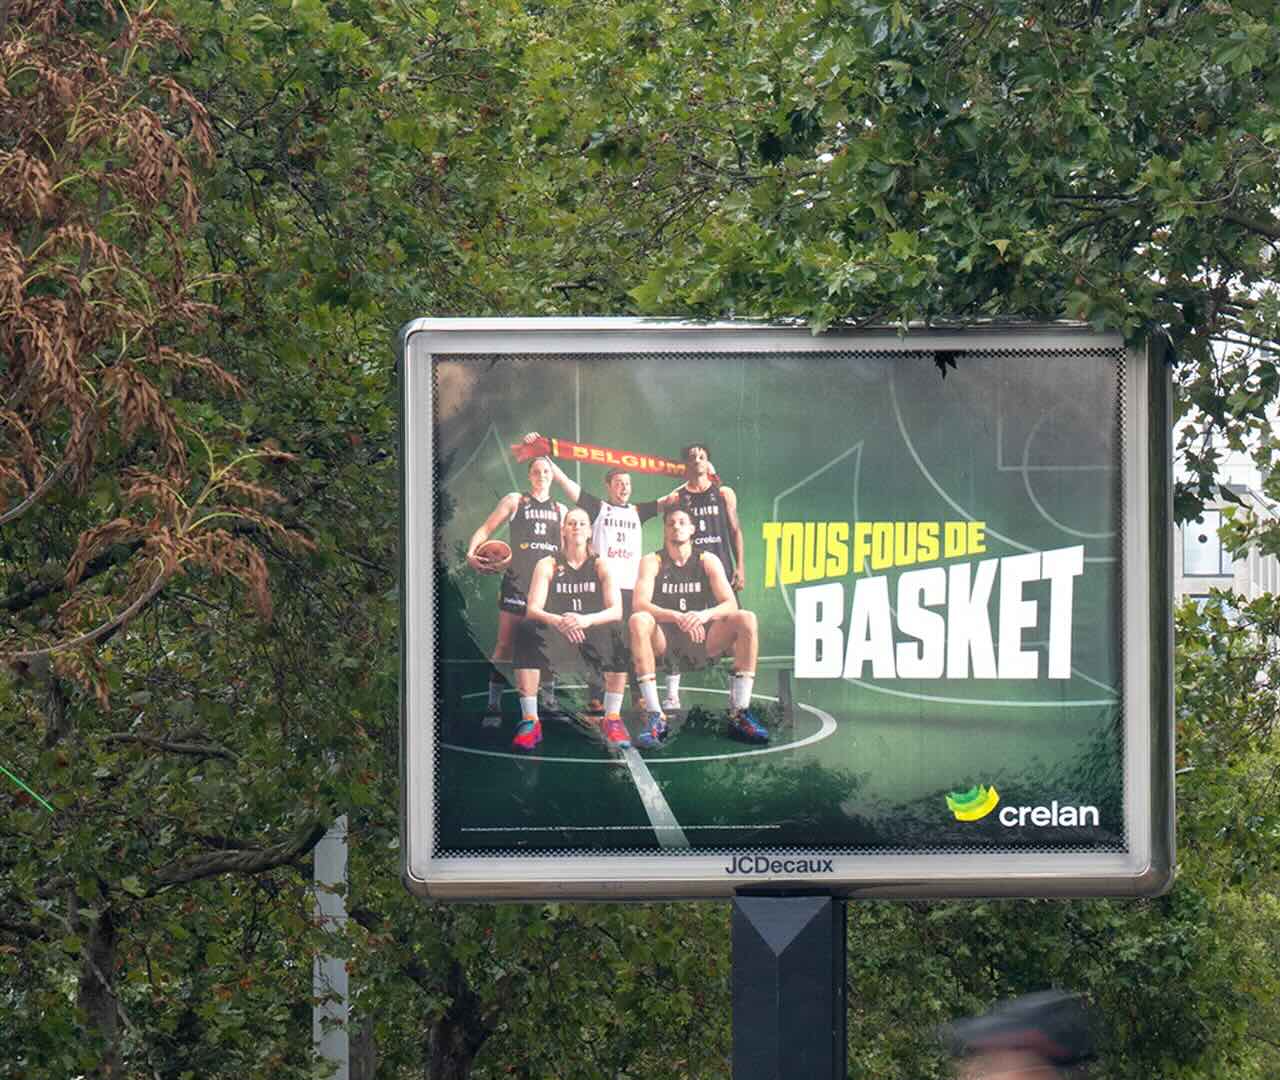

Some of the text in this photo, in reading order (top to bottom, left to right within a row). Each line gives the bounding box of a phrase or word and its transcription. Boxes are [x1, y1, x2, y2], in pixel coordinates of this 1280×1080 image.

[573, 446, 687, 475] BELGIUM
[604, 518, 637, 529] BELGIUM
[530, 541, 558, 551] crelan
[763, 522, 986, 588] TOUS FOUS DE
[794, 544, 1084, 679] BASKET
[999, 801, 1099, 827] crelan
[725, 857, 834, 874] JCDecaux
